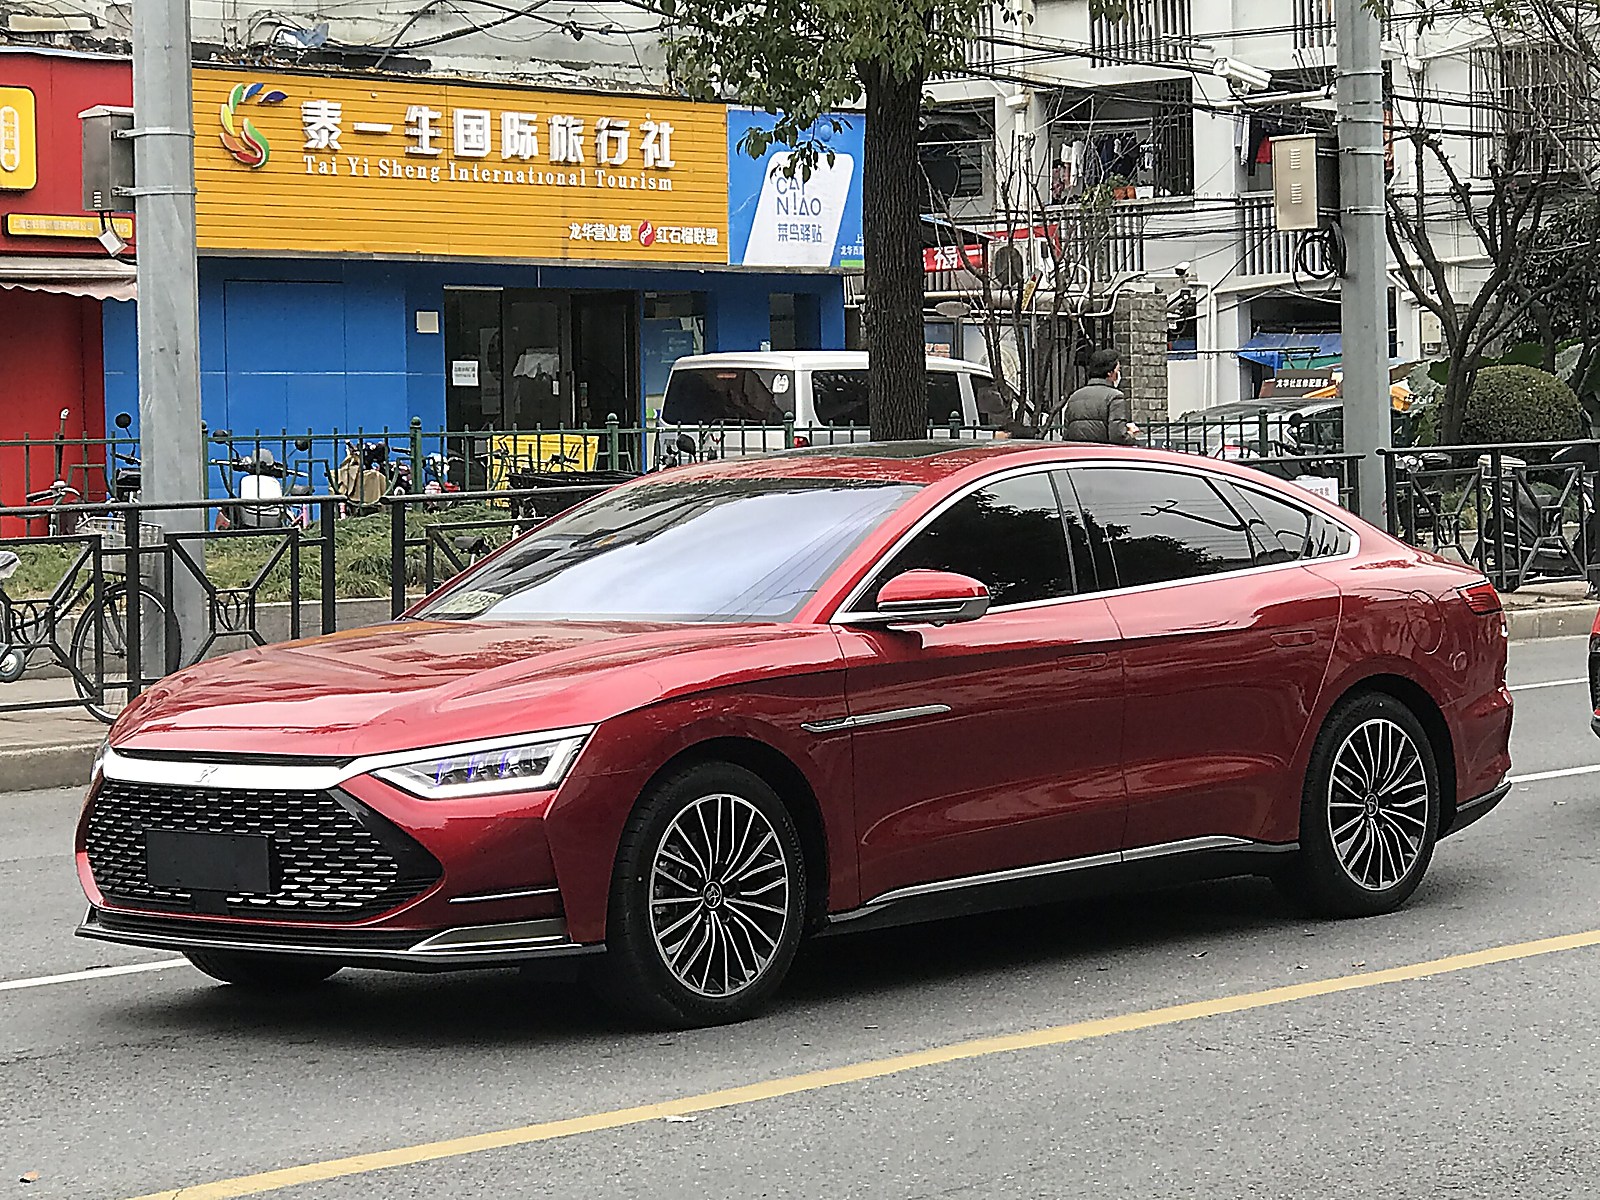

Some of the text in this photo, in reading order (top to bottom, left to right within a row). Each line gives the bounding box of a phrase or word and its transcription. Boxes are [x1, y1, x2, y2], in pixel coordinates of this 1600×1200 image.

[301, 100, 676, 168] 泰一生国际旅行社
[302, 155, 673, 191] Tai Yi Sheng International Tourism
[568, 222, 719, 246] 龙华营业部 红石榴联盟
[777, 223, 822, 243] 菜鸟驿站
